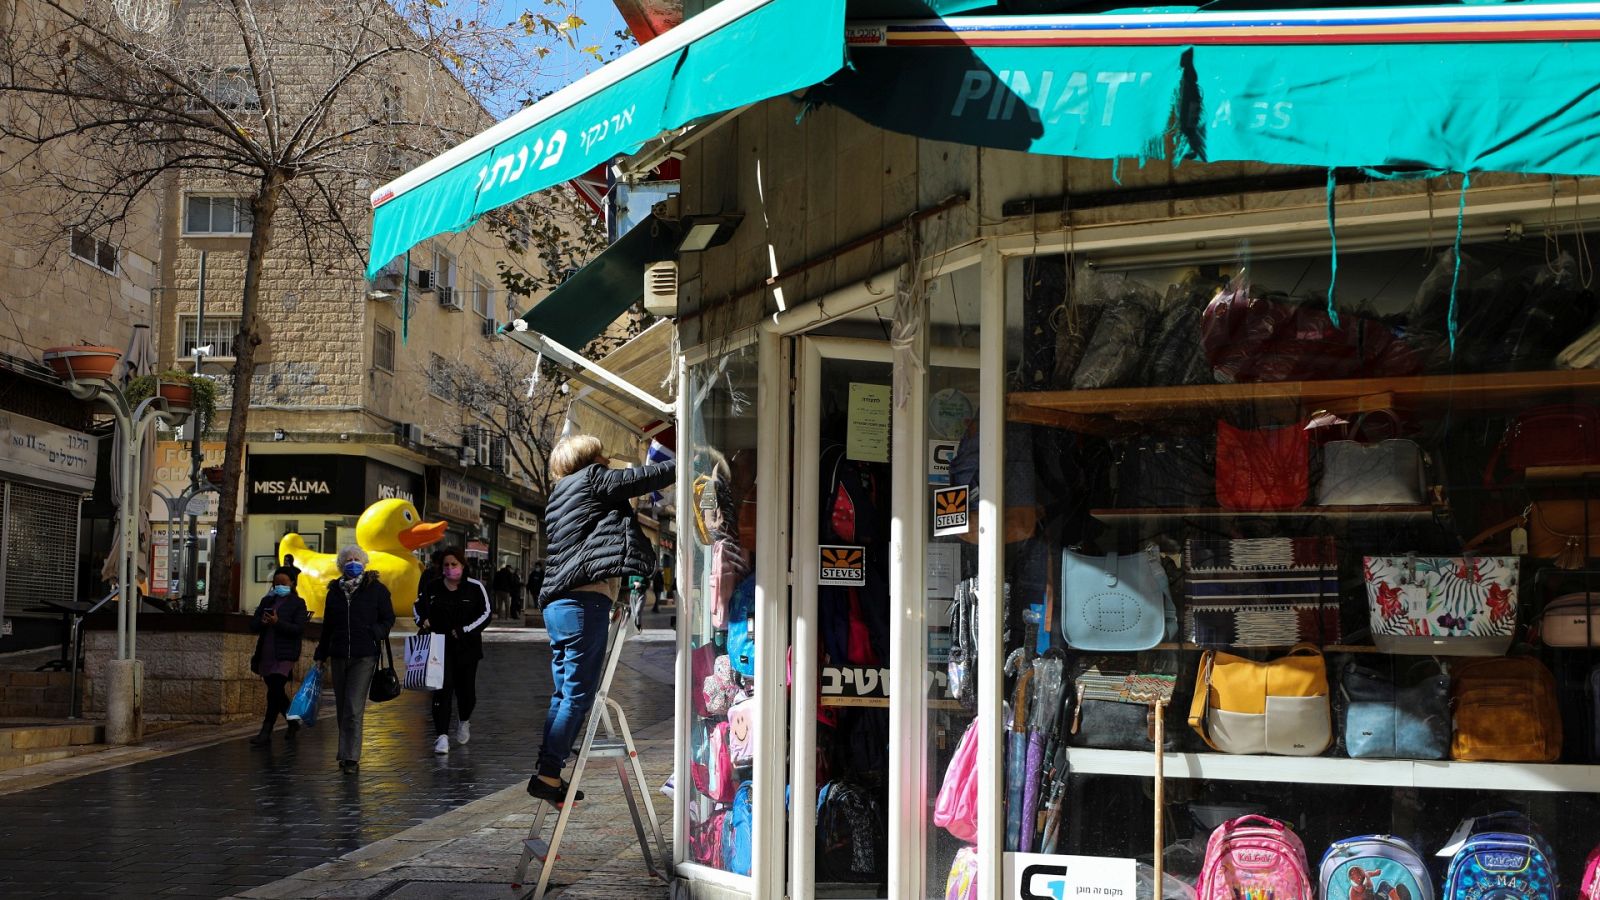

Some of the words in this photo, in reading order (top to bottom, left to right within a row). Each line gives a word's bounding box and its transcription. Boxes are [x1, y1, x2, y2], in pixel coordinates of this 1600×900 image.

[951, 70, 1153, 127] PINAT
[579, 103, 637, 156] ארנקי
[473, 129, 568, 194] פינתי
[68, 432, 89, 451] חלון
[49, 448, 88, 469] ירושלים
[254, 481, 285, 494] MISS
[378, 484, 395, 500] MISS
[937, 513, 965, 526] STEVE'S
[823, 569, 861, 578] STEVE'S
[1093, 887, 1101, 895] זה
[1104, 888, 1123, 897] מקום
